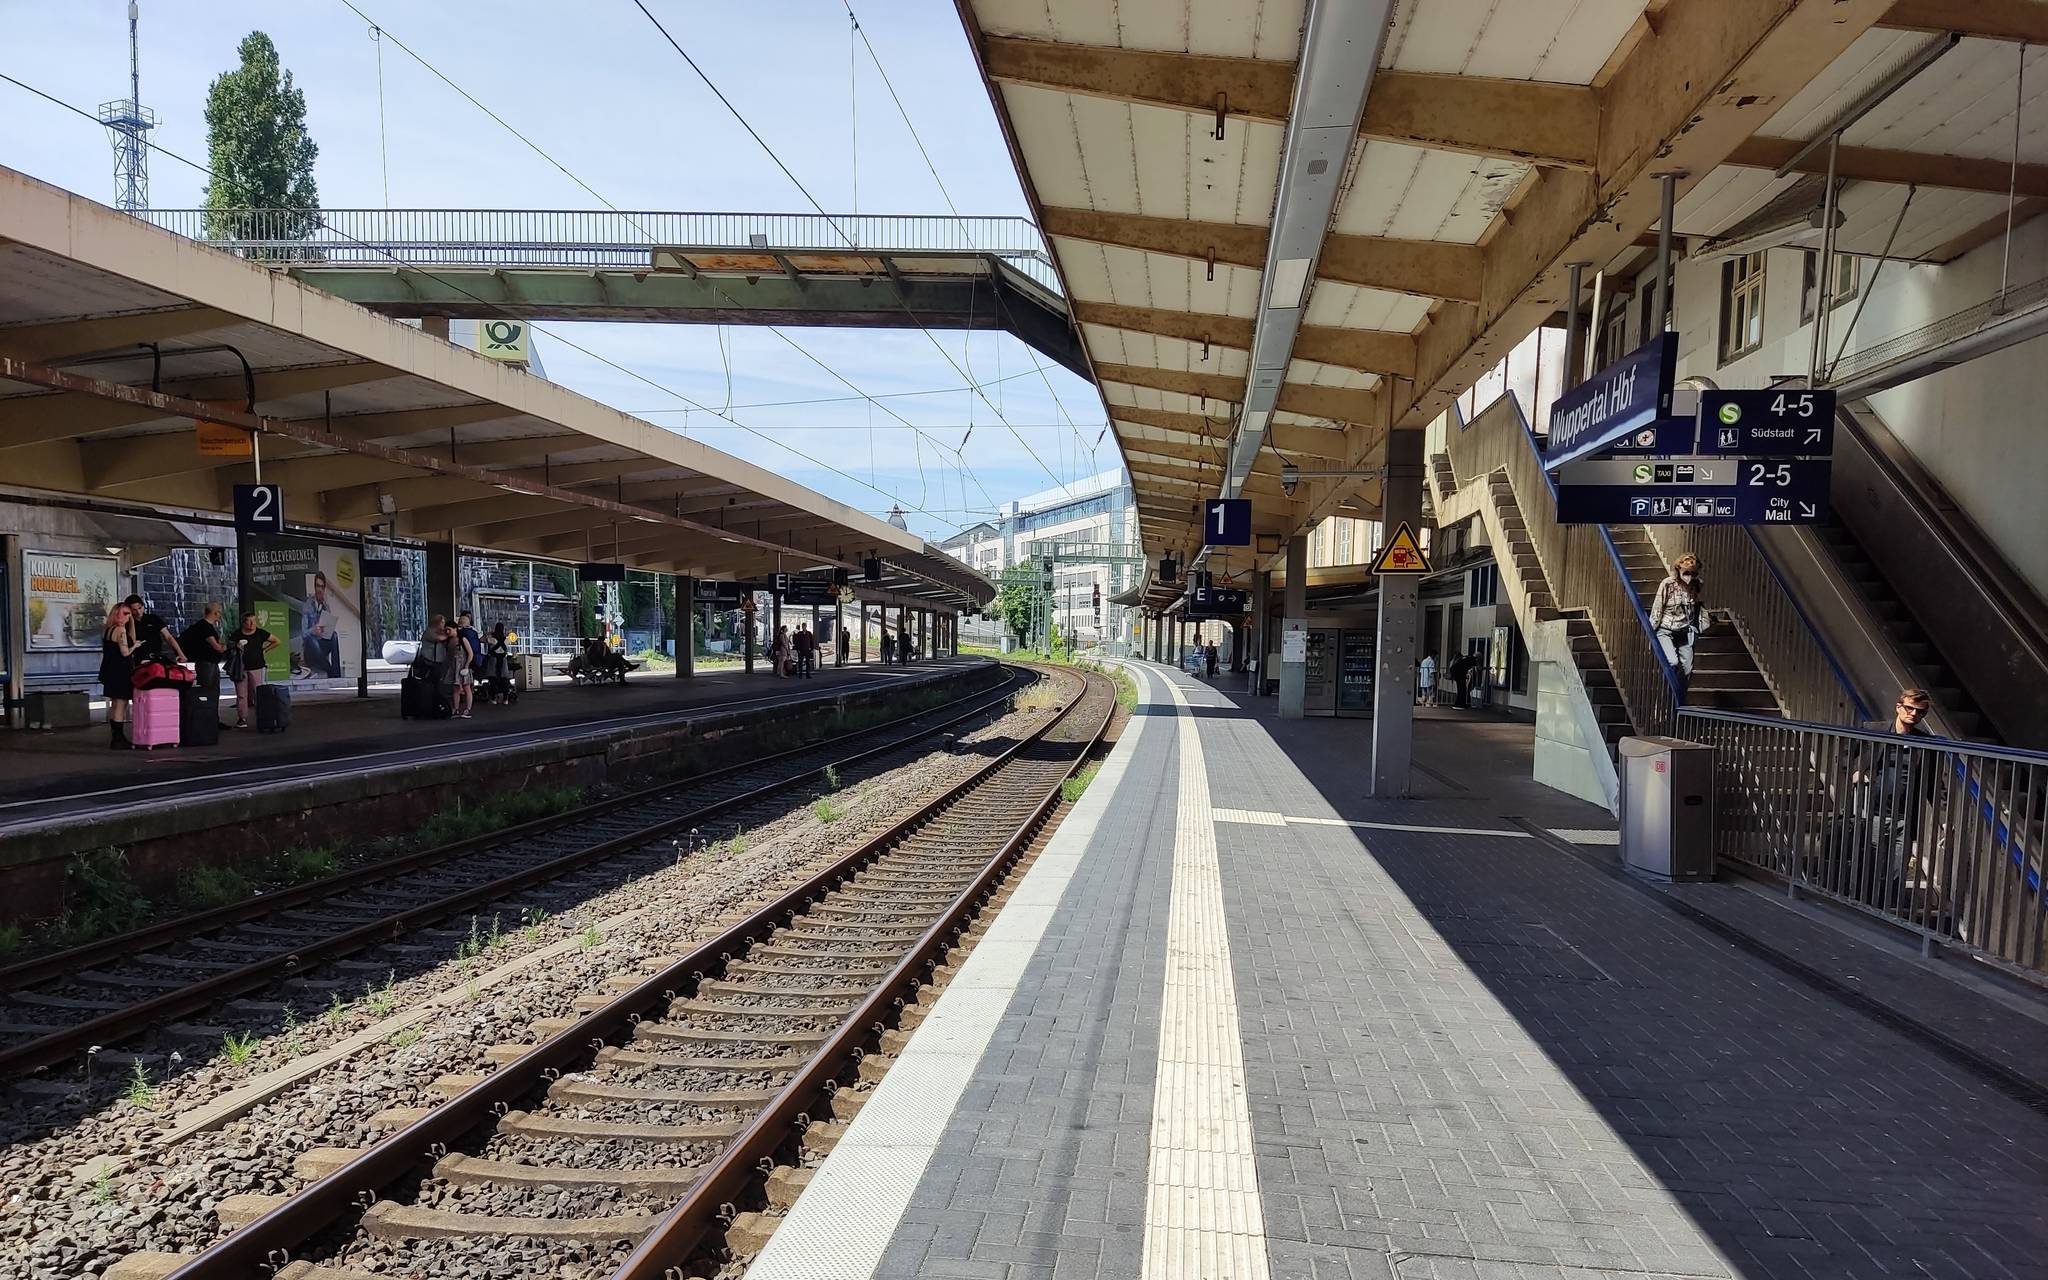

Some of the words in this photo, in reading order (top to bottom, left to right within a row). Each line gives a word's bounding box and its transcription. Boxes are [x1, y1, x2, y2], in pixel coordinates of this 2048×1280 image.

[1552, 381, 1609, 448] Wuppertal
[1610, 364, 1637, 416] Hbf
[1770, 393, 1814, 417] 4-5
[1751, 428, 1795, 438] Südstadt
[1635, 465, 1653, 484] S
[1749, 463, 1791, 486] 2-5
[252, 486, 273, 521] 2
[1636, 503, 1646, 515] P
[1717, 506, 1731, 515] WC
[1770, 497, 1790, 509] City
[1211, 503, 1225, 535] 1
[1765, 509, 1792, 521] Mall
[271, 549, 317, 563] CLEVERDENKER,
[31, 559, 62, 577] KOMM
[64, 562, 77, 578] ZU
[776, 574, 787, 590] E
[520, 595, 526, 604] 5
[536, 595, 543, 604] 4
[1197, 587, 1206, 601] E
[1152, 611, 1158, 619] F
